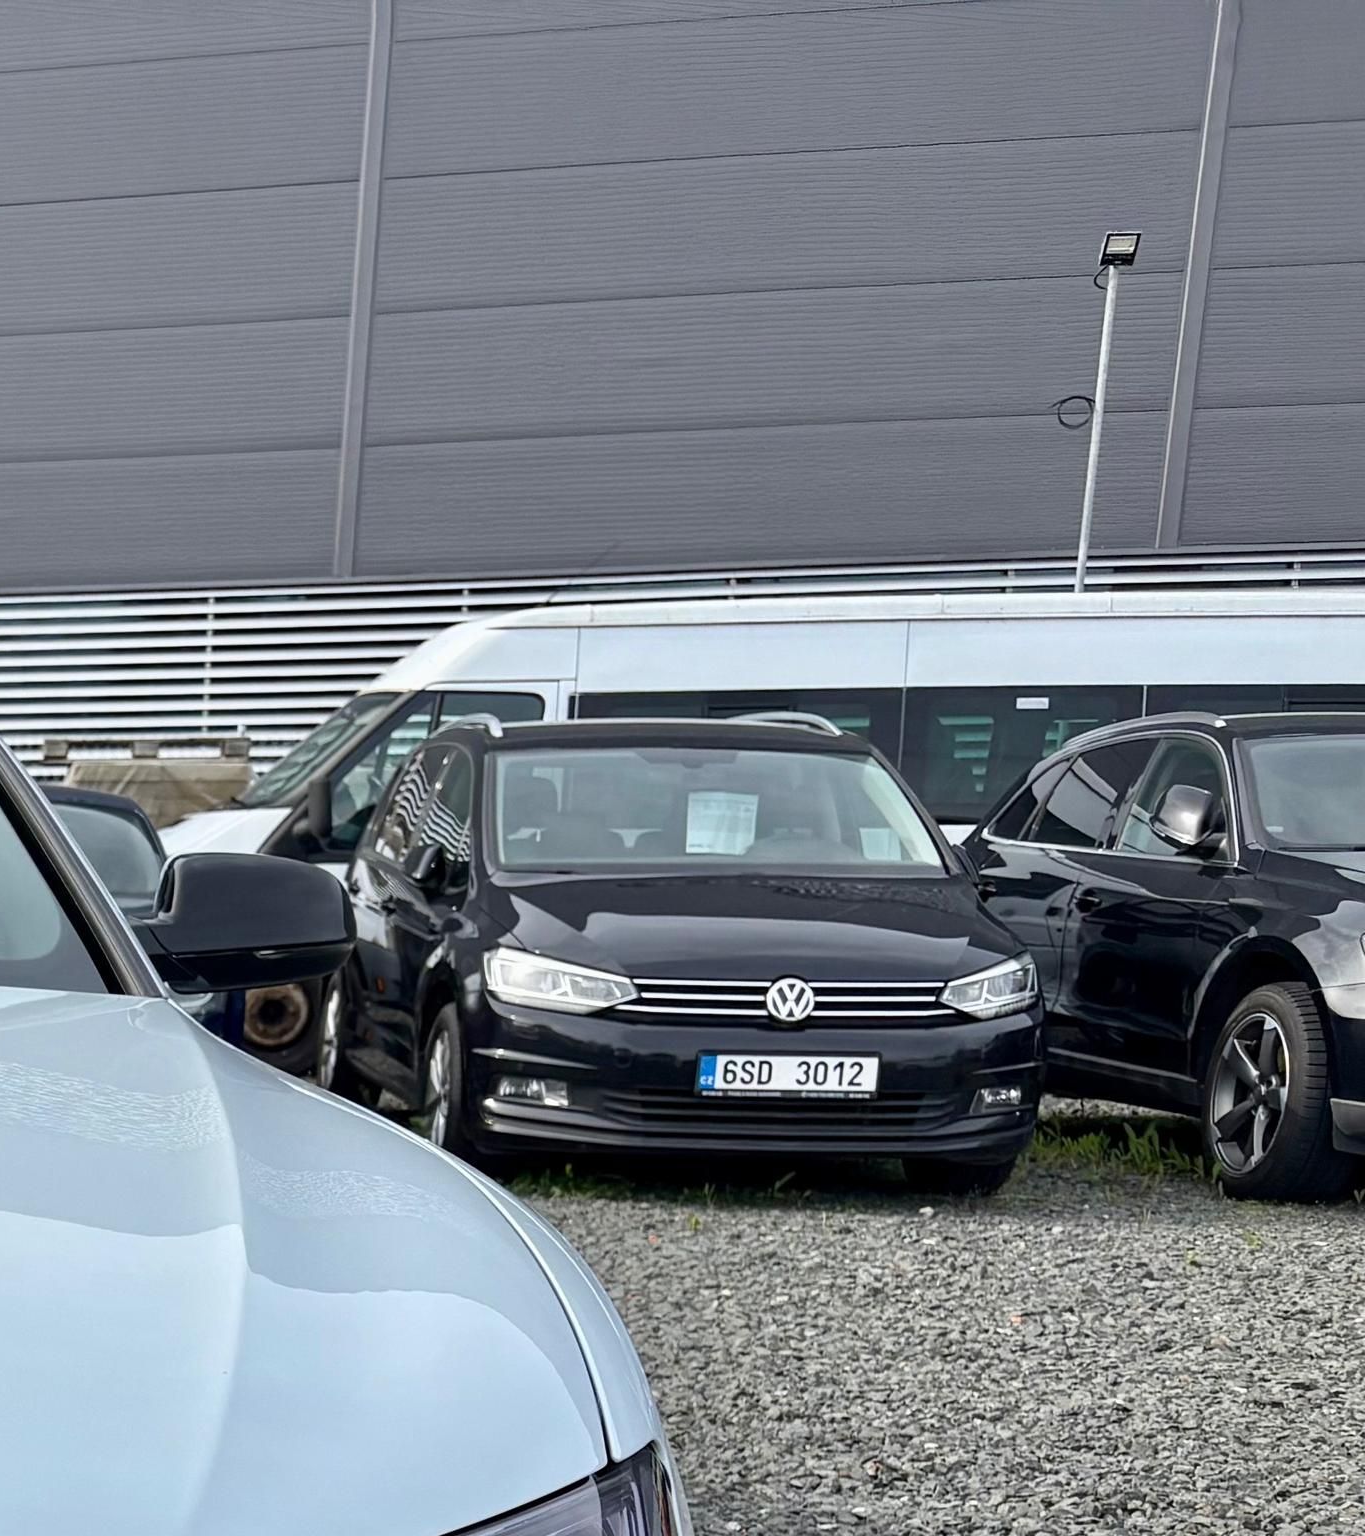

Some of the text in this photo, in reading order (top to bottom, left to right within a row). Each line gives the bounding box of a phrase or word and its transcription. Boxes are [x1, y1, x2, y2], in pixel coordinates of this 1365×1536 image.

[769, 980, 812, 1019] VW
[700, 1075, 715, 1086] CZ
[722, 1060, 864, 1087] 6SD 3012
